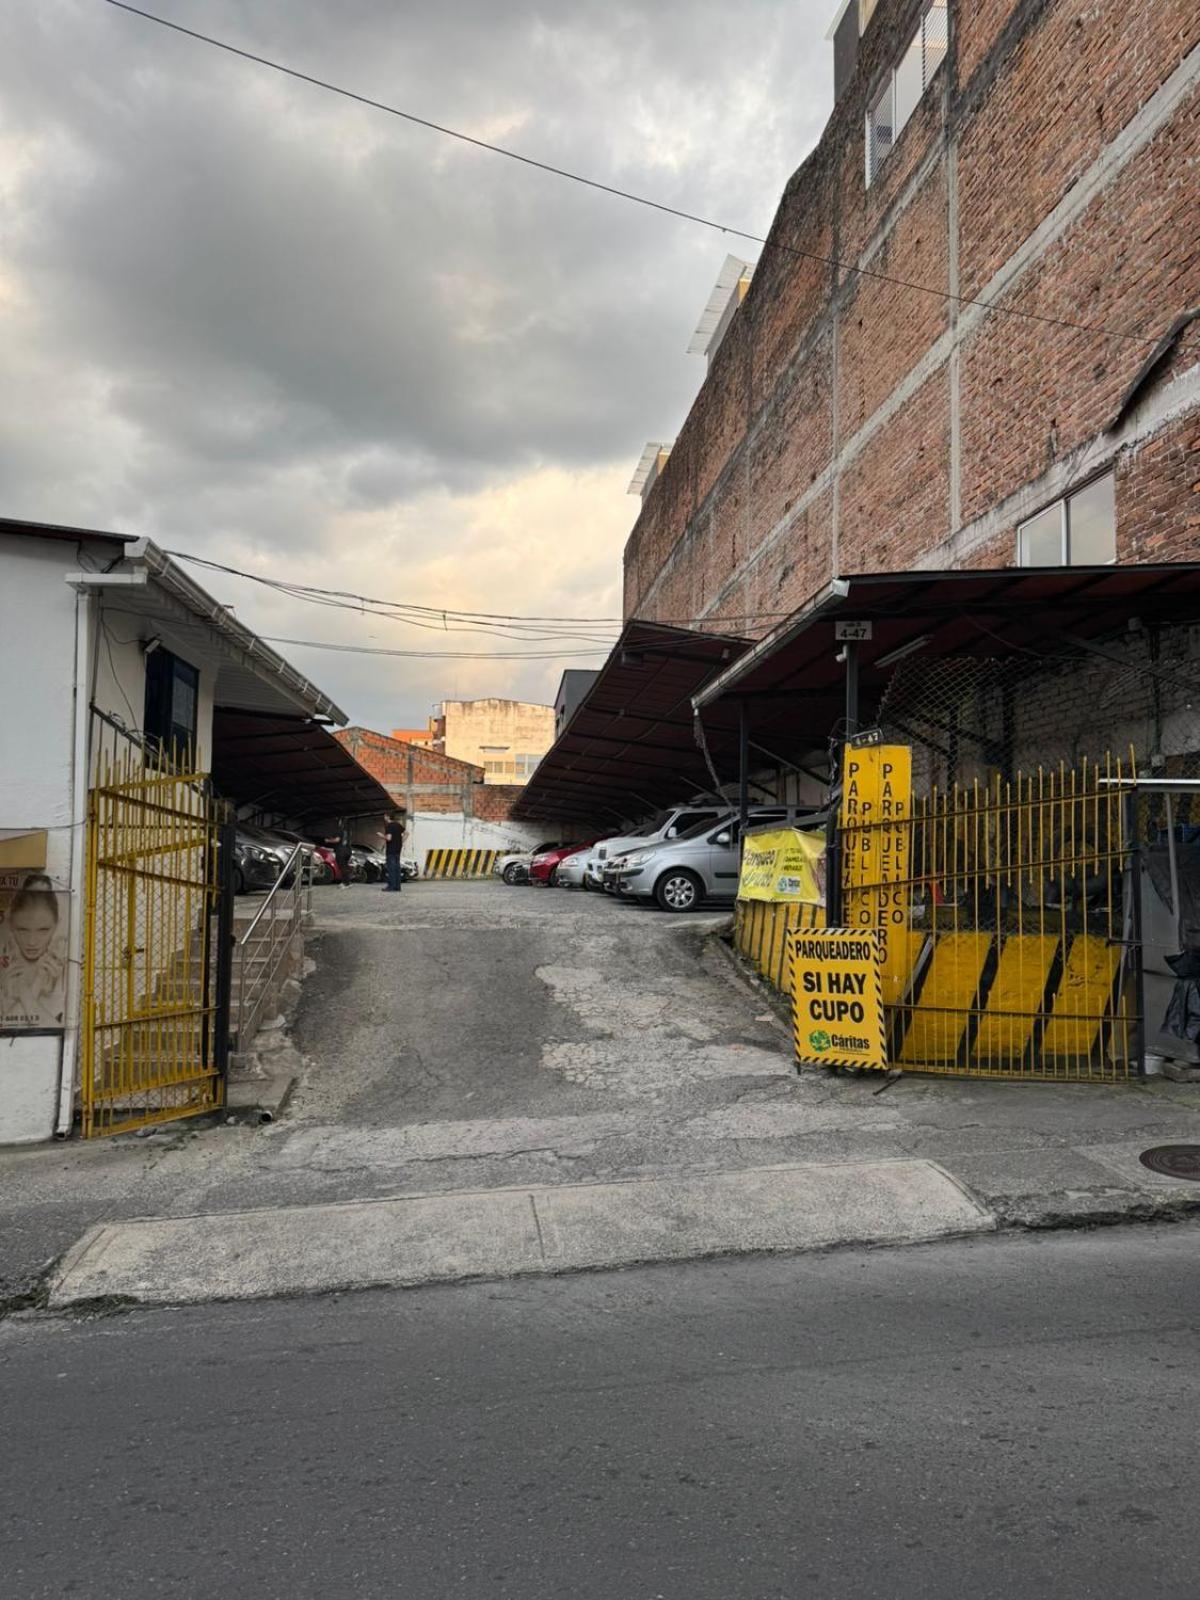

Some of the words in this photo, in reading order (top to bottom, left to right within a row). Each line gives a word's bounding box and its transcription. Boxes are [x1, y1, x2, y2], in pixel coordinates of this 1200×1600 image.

[840, 628, 866, 638] 4-47
[878, 763, 893, 964] PARQUEADERO
[795, 940, 871, 961] PARQUEADERO
[803, 971, 822, 993] SI
[827, 973, 867, 995] HAY
[809, 999, 864, 1023] CUPO
